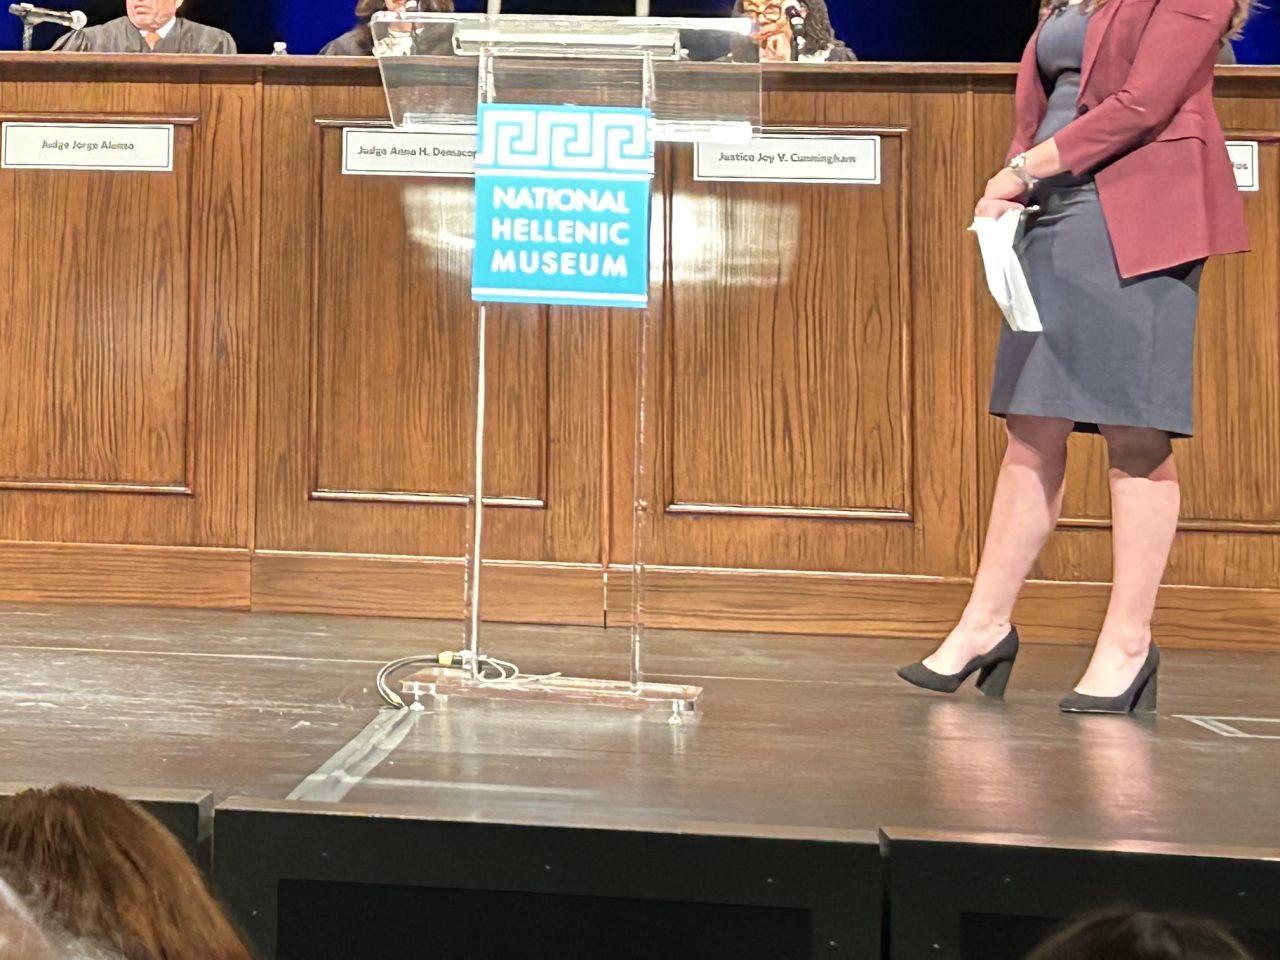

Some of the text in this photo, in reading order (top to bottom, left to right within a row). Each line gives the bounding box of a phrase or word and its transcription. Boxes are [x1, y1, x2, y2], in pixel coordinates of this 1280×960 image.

[41, 139, 135, 152] Judge Jorge Alonso
[357, 145, 387, 157] Judge
[390, 146, 417, 156] Anna
[419, 146, 431, 156] H.
[718, 152, 857, 165] Justice Joy V. Cunningham
[492, 185, 631, 214] NATIONAL
[491, 216, 631, 246] HELLENIC
[490, 249, 629, 278] MUSEUM
